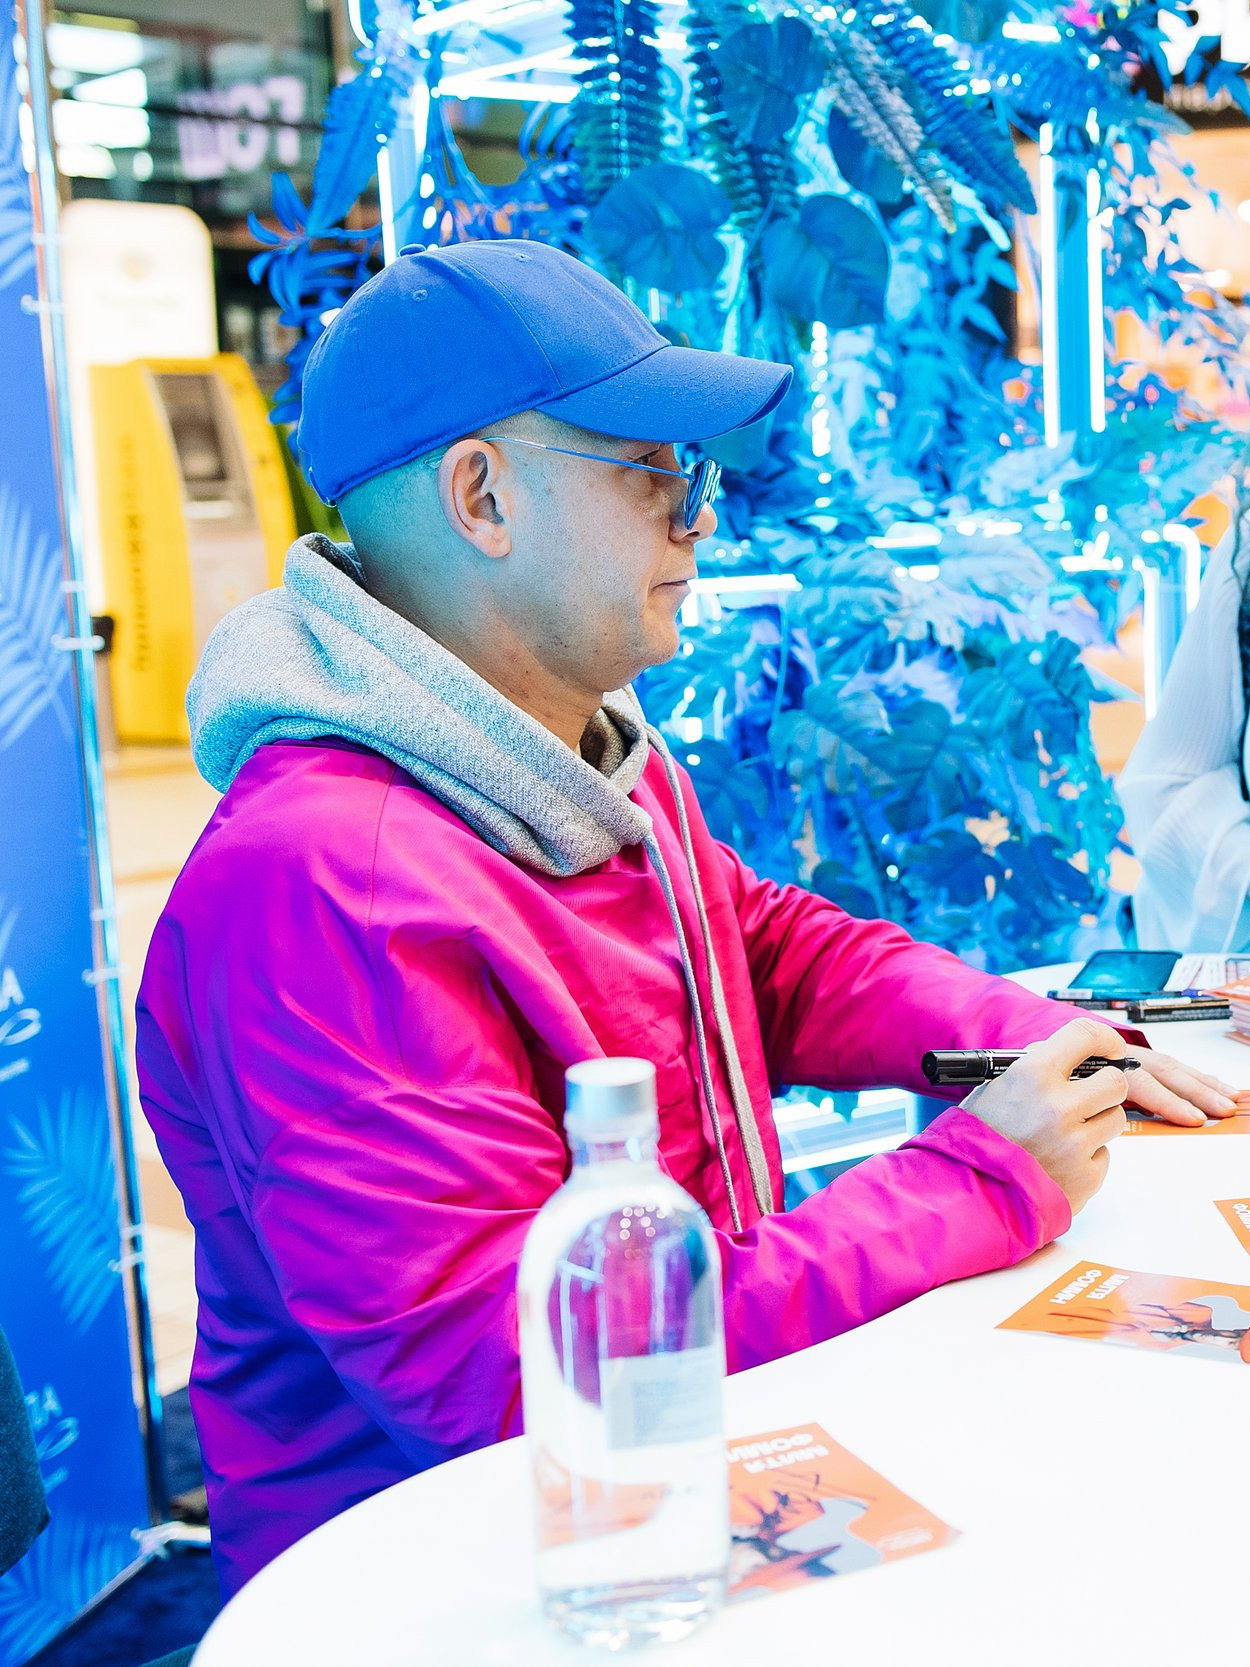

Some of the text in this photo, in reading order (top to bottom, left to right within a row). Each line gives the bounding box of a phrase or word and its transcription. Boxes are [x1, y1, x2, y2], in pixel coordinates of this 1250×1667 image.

[1049, 1269, 1102, 1305] ФОМИН
[1085, 1273, 1130, 1300] МИТЯ
[743, 1444, 829, 1473] МИТЯ
